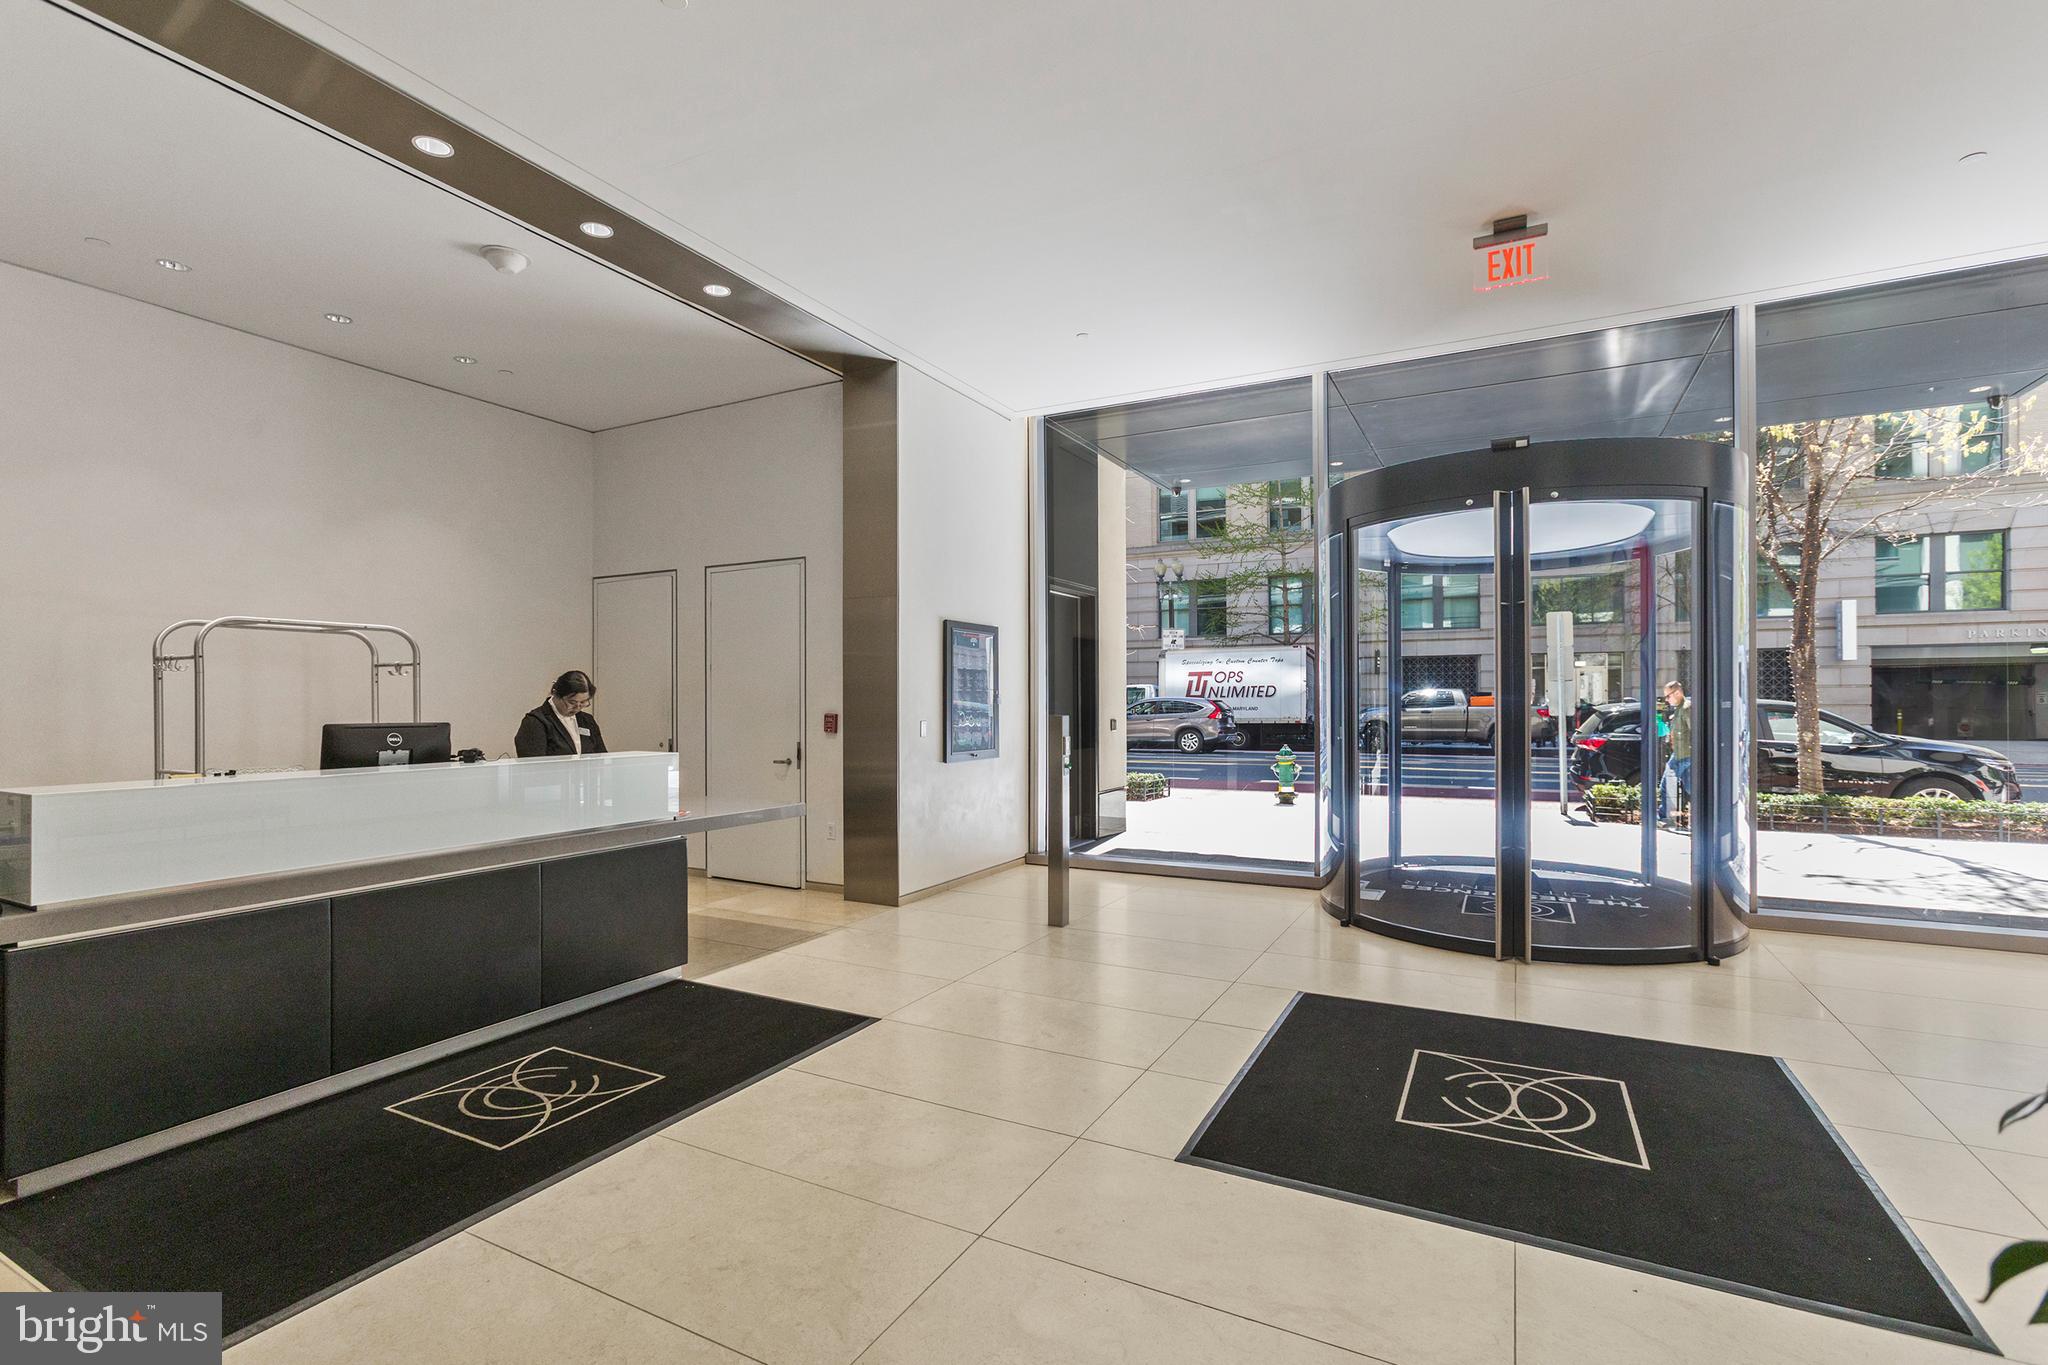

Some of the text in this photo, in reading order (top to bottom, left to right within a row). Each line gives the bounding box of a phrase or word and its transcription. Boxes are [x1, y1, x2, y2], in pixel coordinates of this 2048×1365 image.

[1488, 243, 1535, 282] EXIT
[1967, 628, 2048, 639] PARKIN
[1270, 656, 1284, 664] Tops
